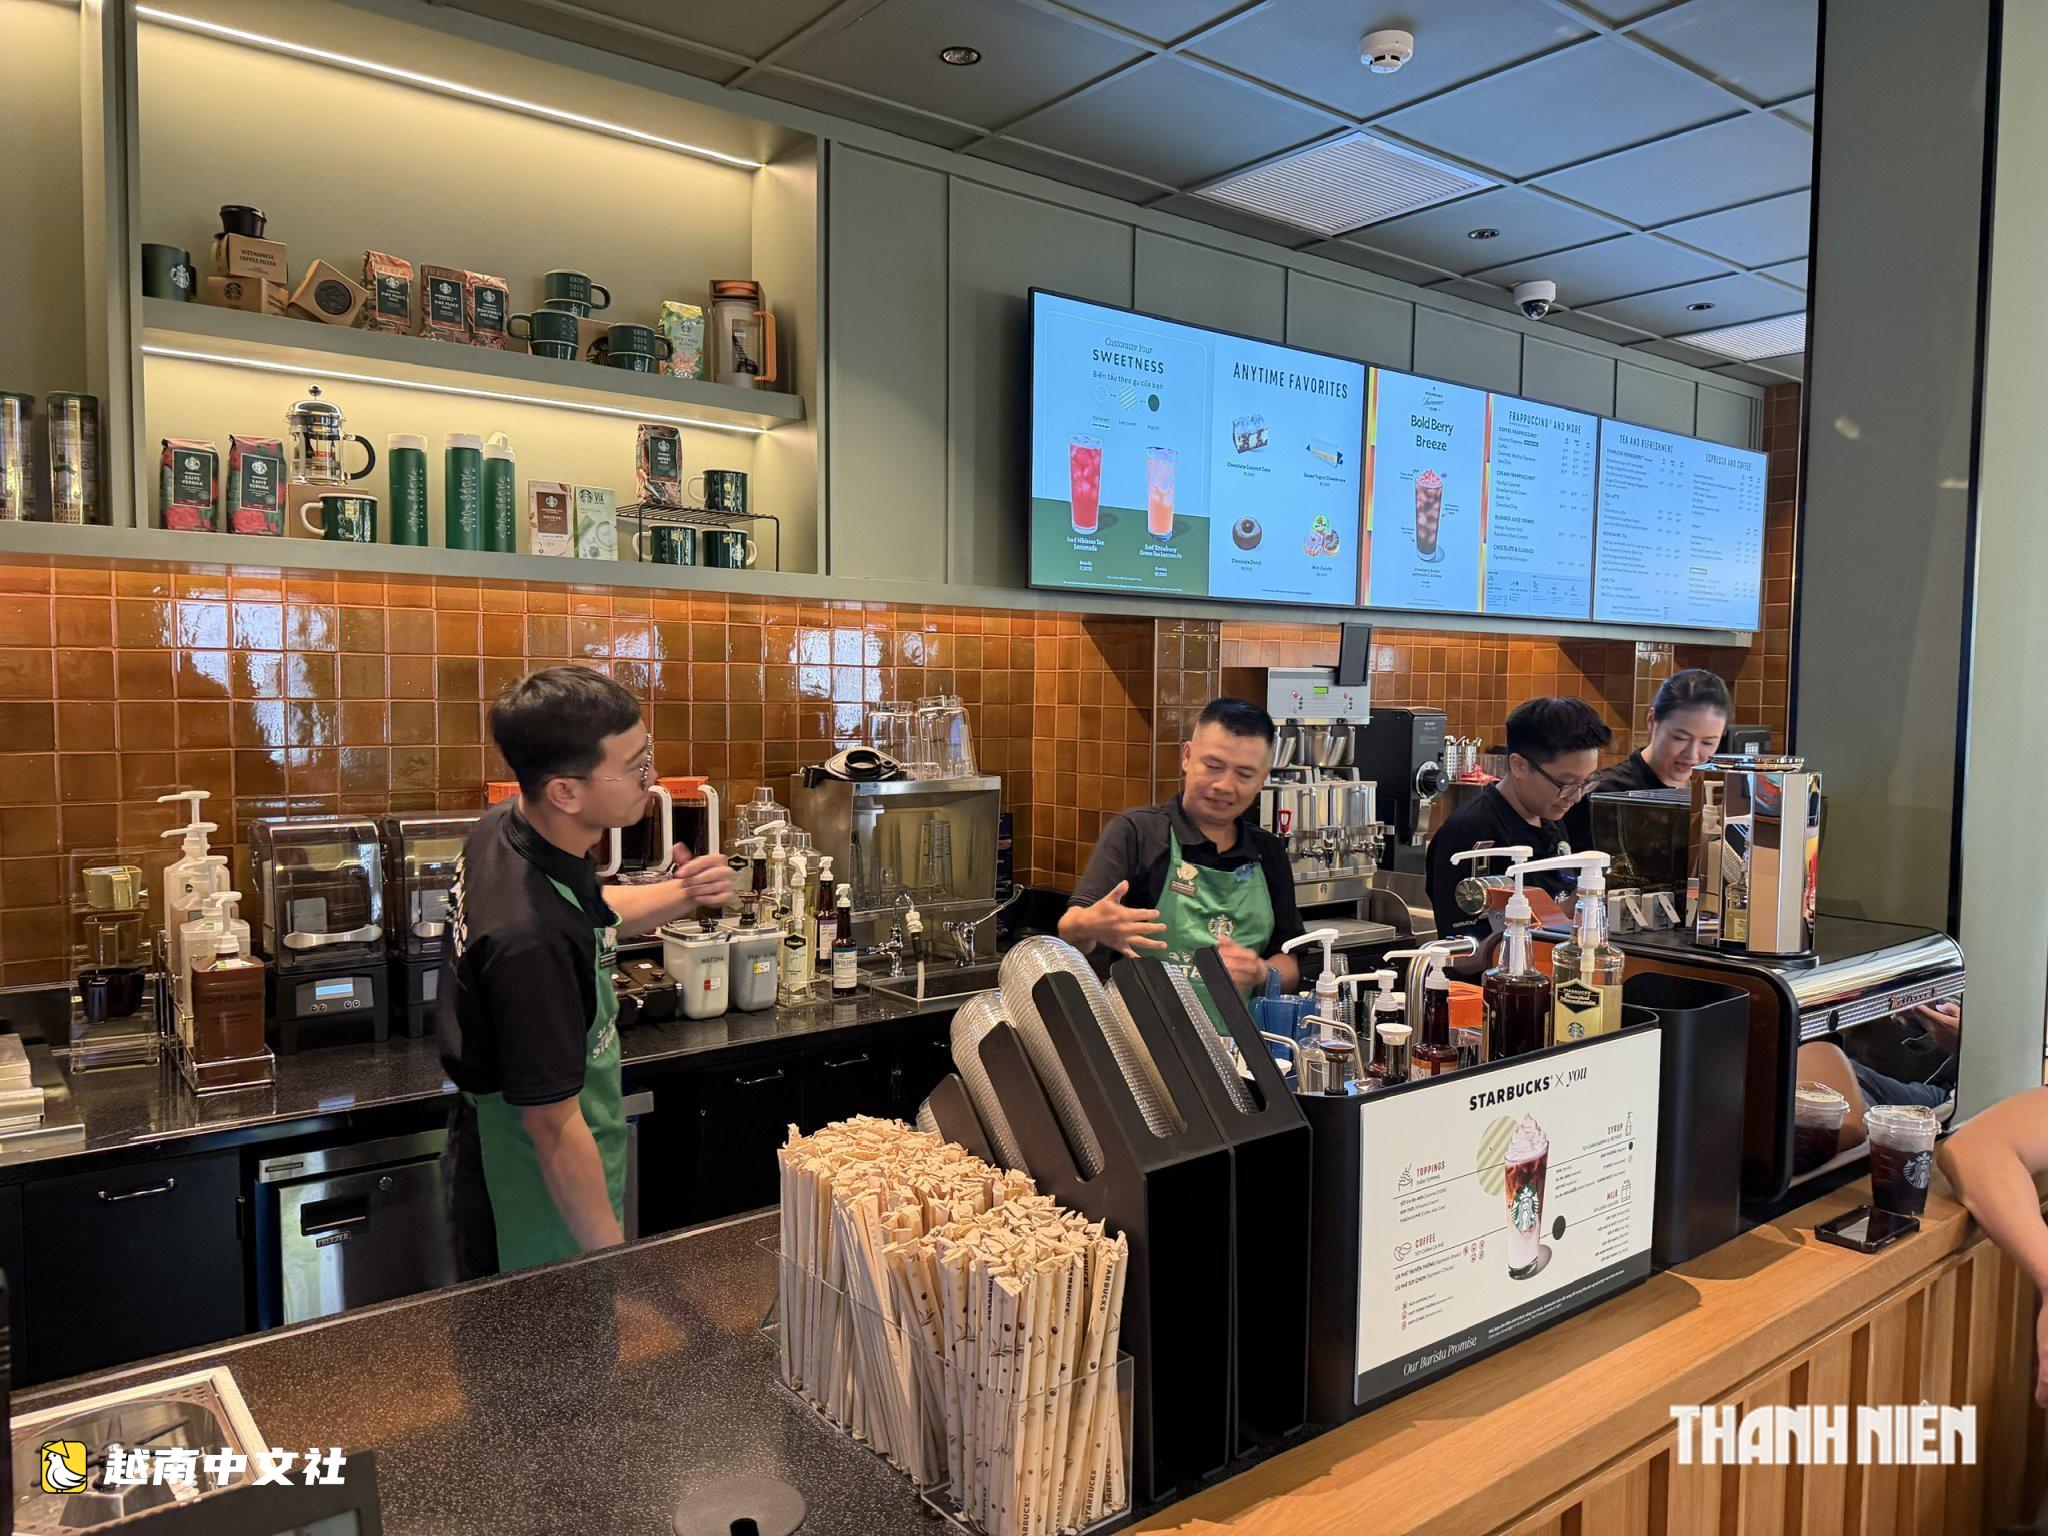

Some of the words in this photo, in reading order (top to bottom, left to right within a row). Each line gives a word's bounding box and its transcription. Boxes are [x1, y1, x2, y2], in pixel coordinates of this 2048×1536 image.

[1104, 337, 1138, 352] Customize
[1092, 348, 1164, 375] SWEETNESS
[1233, 361, 1285, 388] ANYTIME
[1289, 373, 1348, 399] FAVORITES
[1411, 414, 1430, 429] Bold
[1431, 418, 1454, 437] Berry
[1553, 420, 1565, 431] AND
[1566, 423, 1581, 435] MORE
[1416, 434, 1447, 451] Breeze
[1619, 434, 1628, 444] TEA
[1630, 436, 1640, 447] AND
[1641, 439, 1673, 454] REFRESHMENT
[1469, 1076, 1551, 1111] STARBUCKS
[1566, 1066, 1587, 1088] you
[1607, 1122, 1623, 1136] SYRUP
[1416, 1160, 1445, 1177] TOPPINGS
[1607, 1188, 1619, 1200] MILK
[317, 1232, 350, 1248] FREEZER
[1415, 1232, 1436, 1248] COFFEE
[1099, 1263, 1113, 1313] TARBUCKS
[1403, 1360, 1419, 1376] Our
[1420, 1348, 1447, 1369] Barista
[1447, 1336, 1477, 1357] Promise
[1022, 1496, 1031, 1536] ARBUCKS
